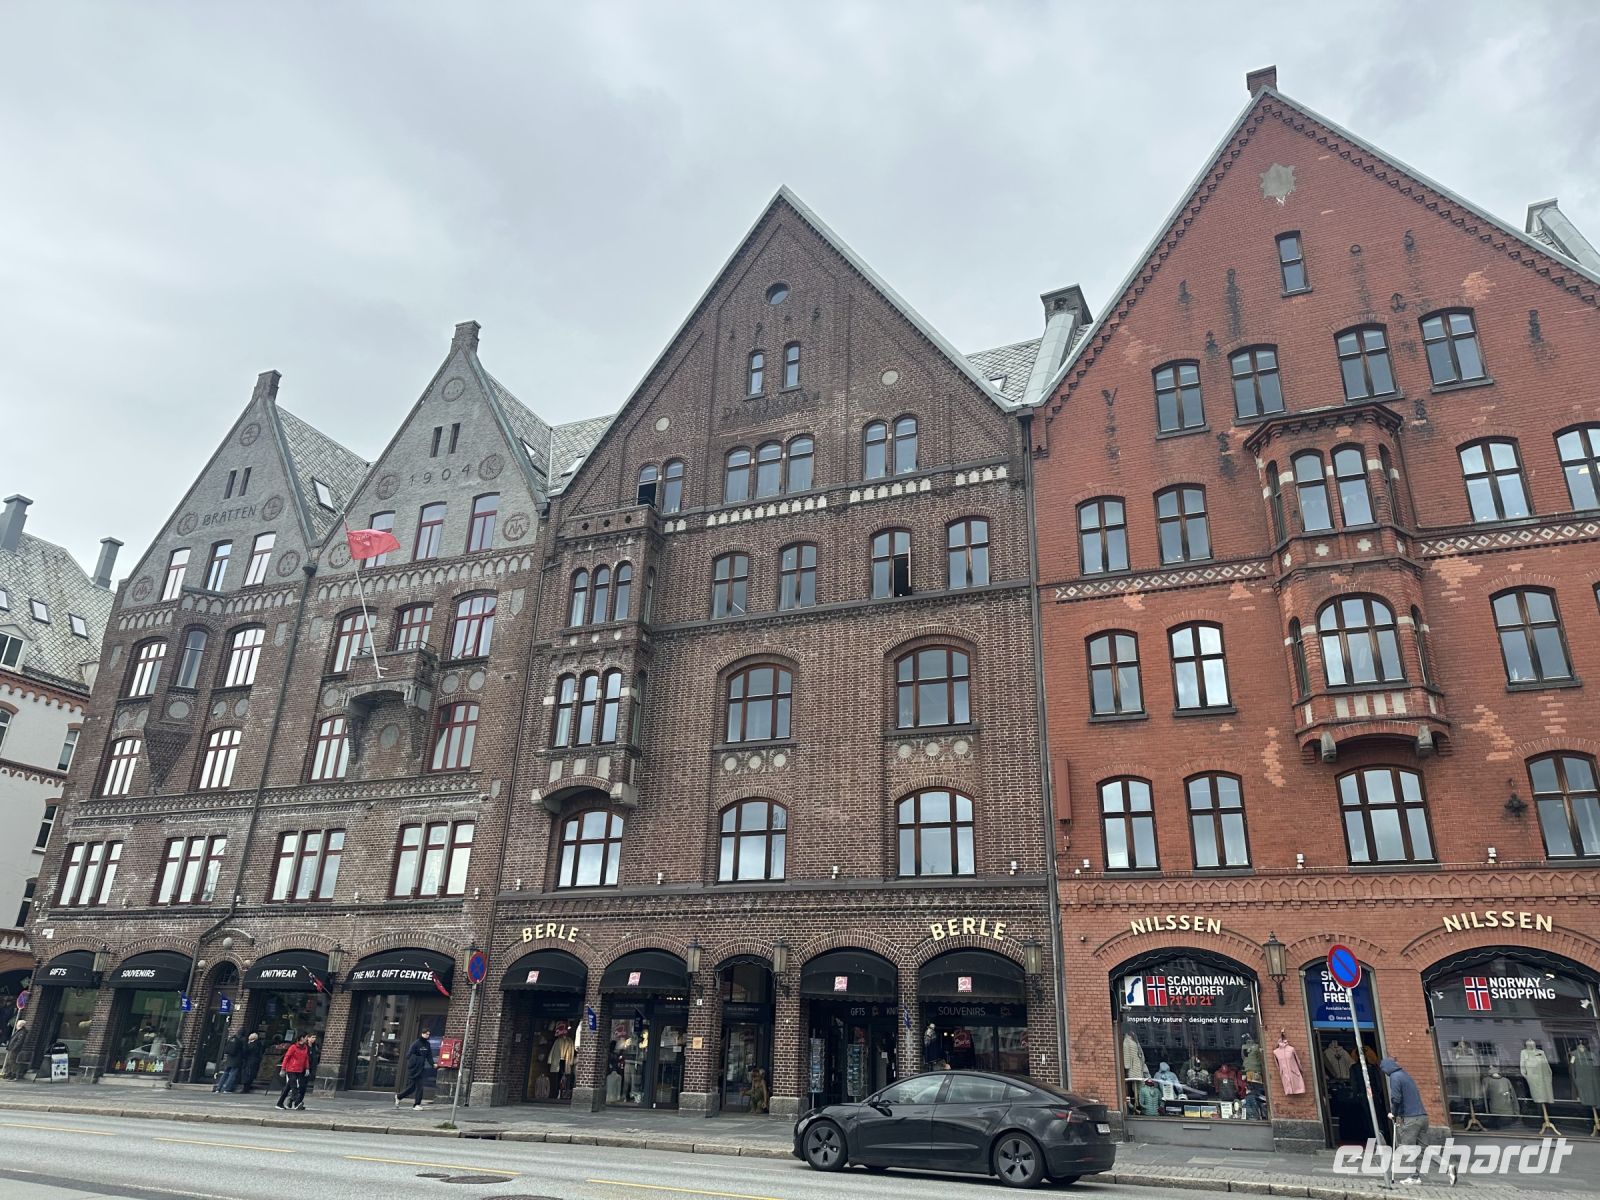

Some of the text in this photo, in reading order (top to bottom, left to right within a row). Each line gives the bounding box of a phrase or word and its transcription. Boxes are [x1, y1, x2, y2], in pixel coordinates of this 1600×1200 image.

[409, 463, 472, 487] 1904
[201, 505, 257, 526] BRATTEN
[1130, 914, 1221, 936] NILSSEN
[1442, 910, 1553, 933] NILSSEN
[522, 922, 579, 943] BERLE
[930, 917, 1007, 941] BERLE
[49, 968, 68, 976] GIFTS
[120, 969, 156, 978] SOUVENIRS
[260, 969, 298, 978] KNITWEAR
[352, 970, 365, 980] THE
[381, 969, 400, 978] GIFT
[400, 969, 434, 981] CENTRE
[1167, 976, 1244, 986] SCANDINAVIAN
[1321, 981, 1345, 991] TAX
[1489, 977, 1541, 988] NORWAY
[1168, 986, 1224, 996] EXPLORER
[1490, 988, 1556, 999] SHOPPING
[850, 1007, 866, 1016] GIFTS
[938, 1006, 986, 1016] SOUVENIRS
[1127, 1016, 1152, 1024] Inspired
[1153, 1016, 1160, 1024] by
[1188, 1016, 1218, 1025] designed
[1230, 1016, 1249, 1024] travel
